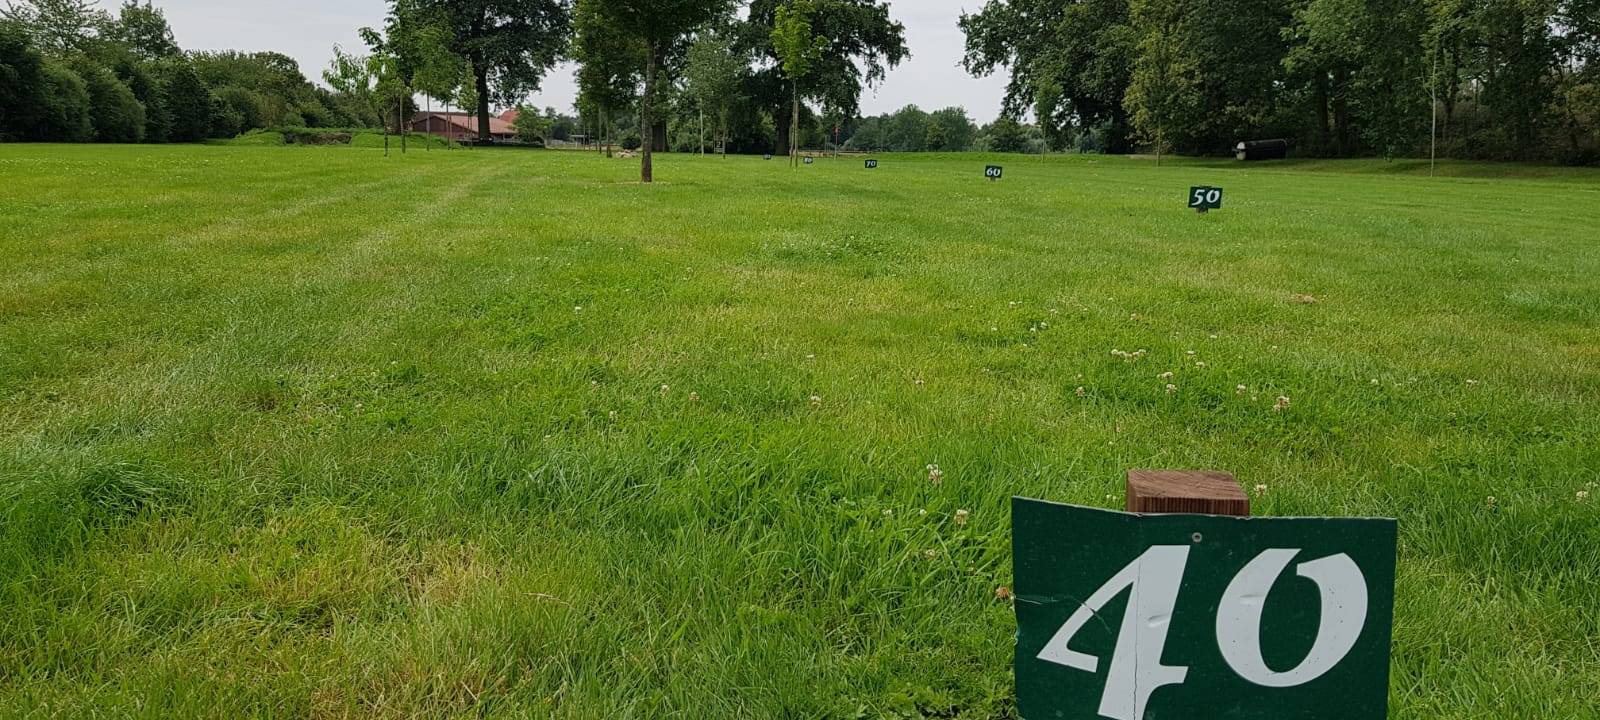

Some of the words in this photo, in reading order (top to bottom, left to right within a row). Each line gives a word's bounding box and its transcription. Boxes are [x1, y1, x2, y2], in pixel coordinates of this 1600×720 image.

[986, 167, 1001, 177] 60
[1191, 189, 1220, 206] 50
[1036, 544, 1368, 720] 40
